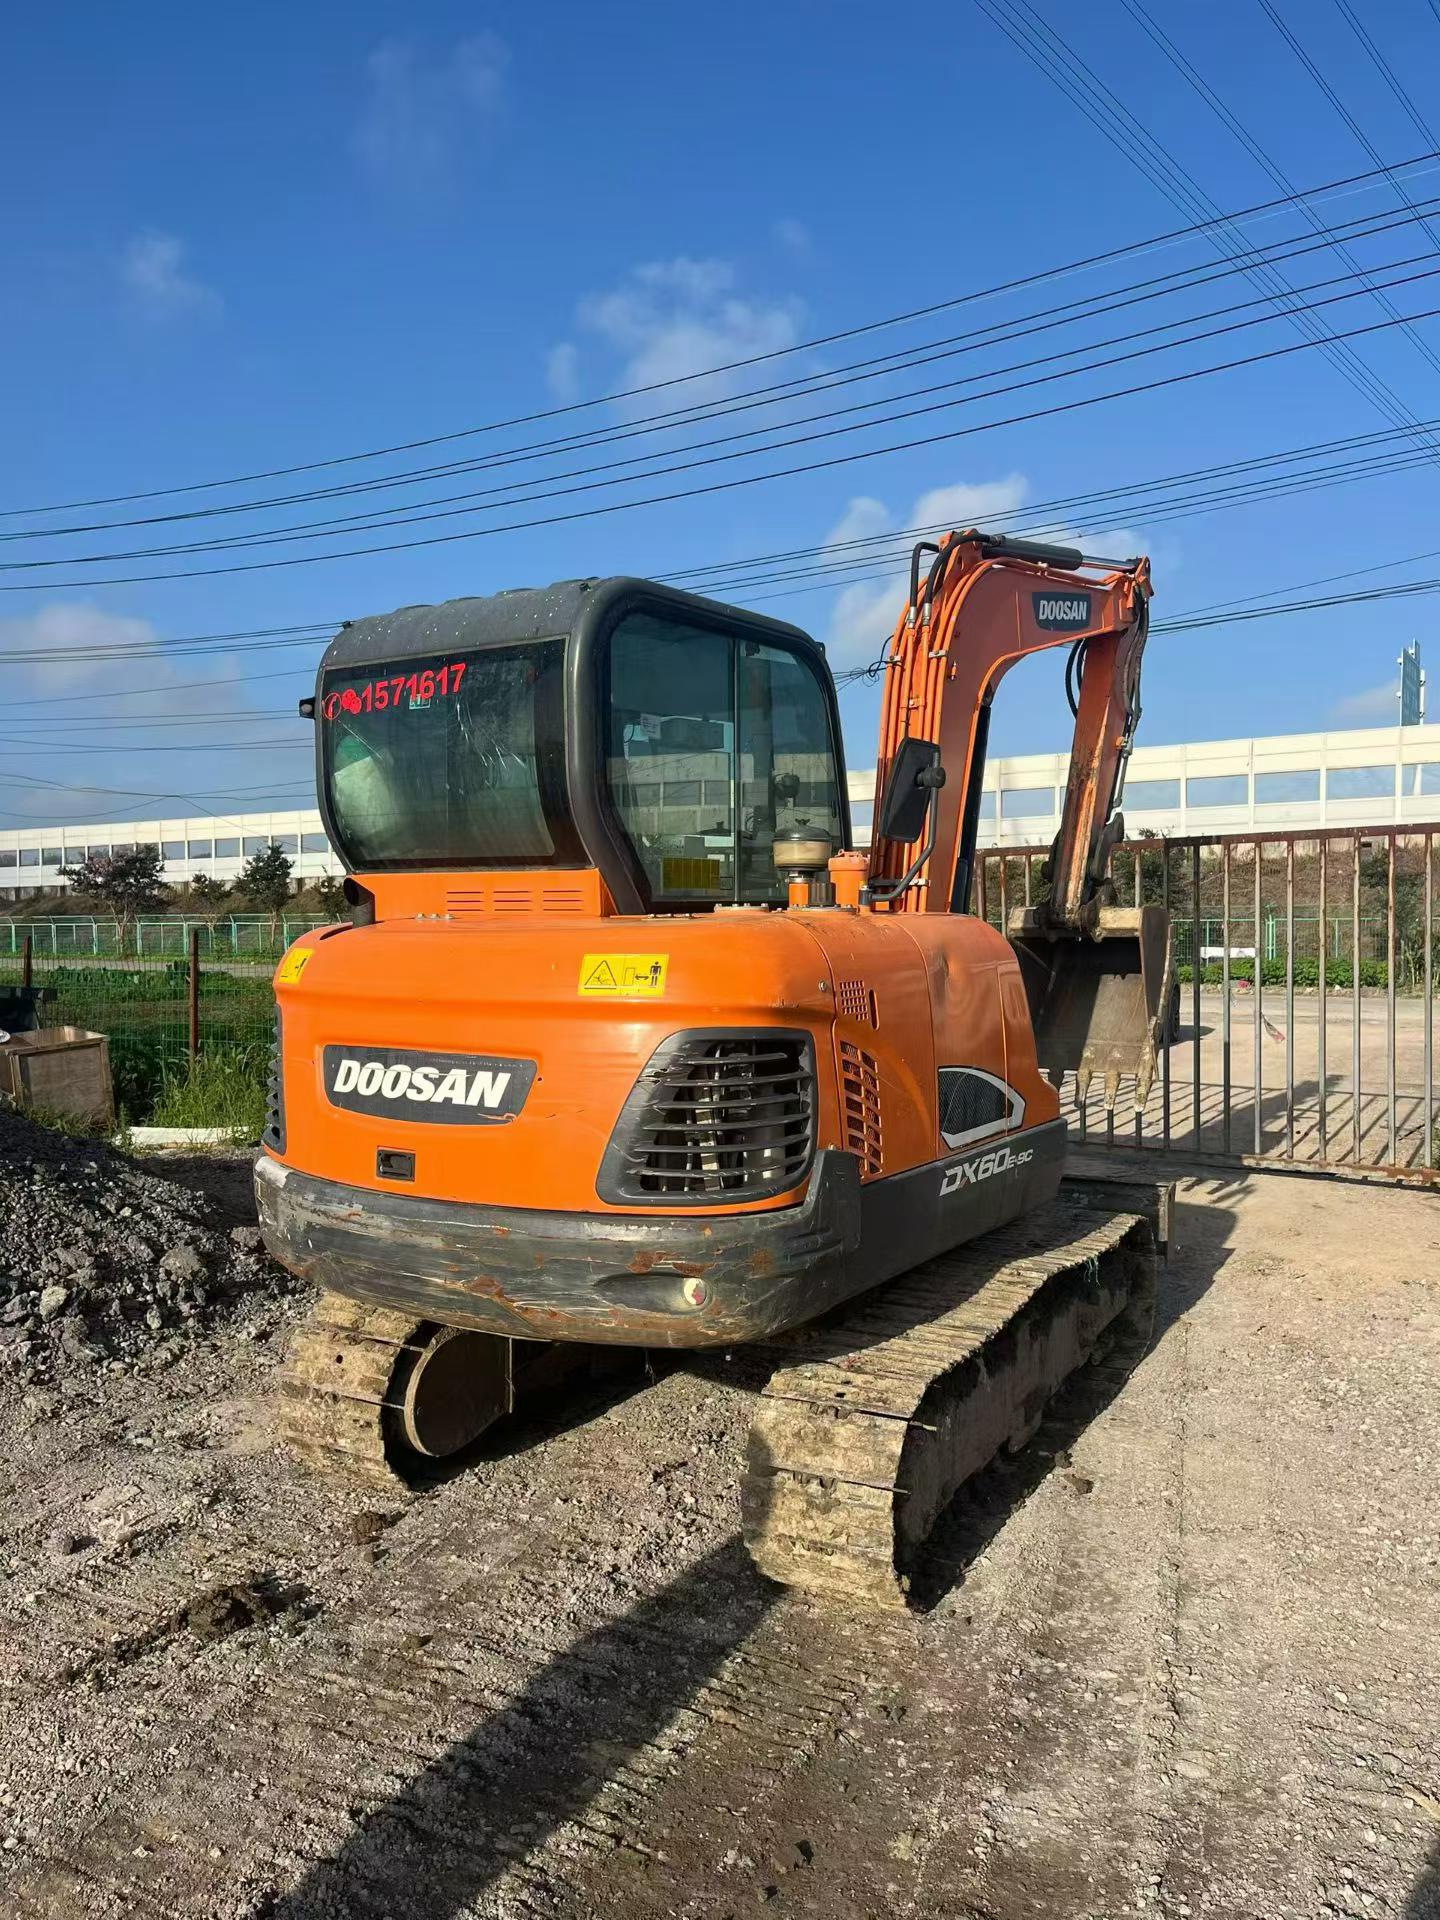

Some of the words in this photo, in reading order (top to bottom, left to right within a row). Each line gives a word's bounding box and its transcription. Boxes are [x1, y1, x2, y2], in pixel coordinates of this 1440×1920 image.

[1039, 600, 1088, 620] DOOSAN
[361, 662, 467, 712] 1571617
[333, 1059, 511, 1108] DOOSAN
